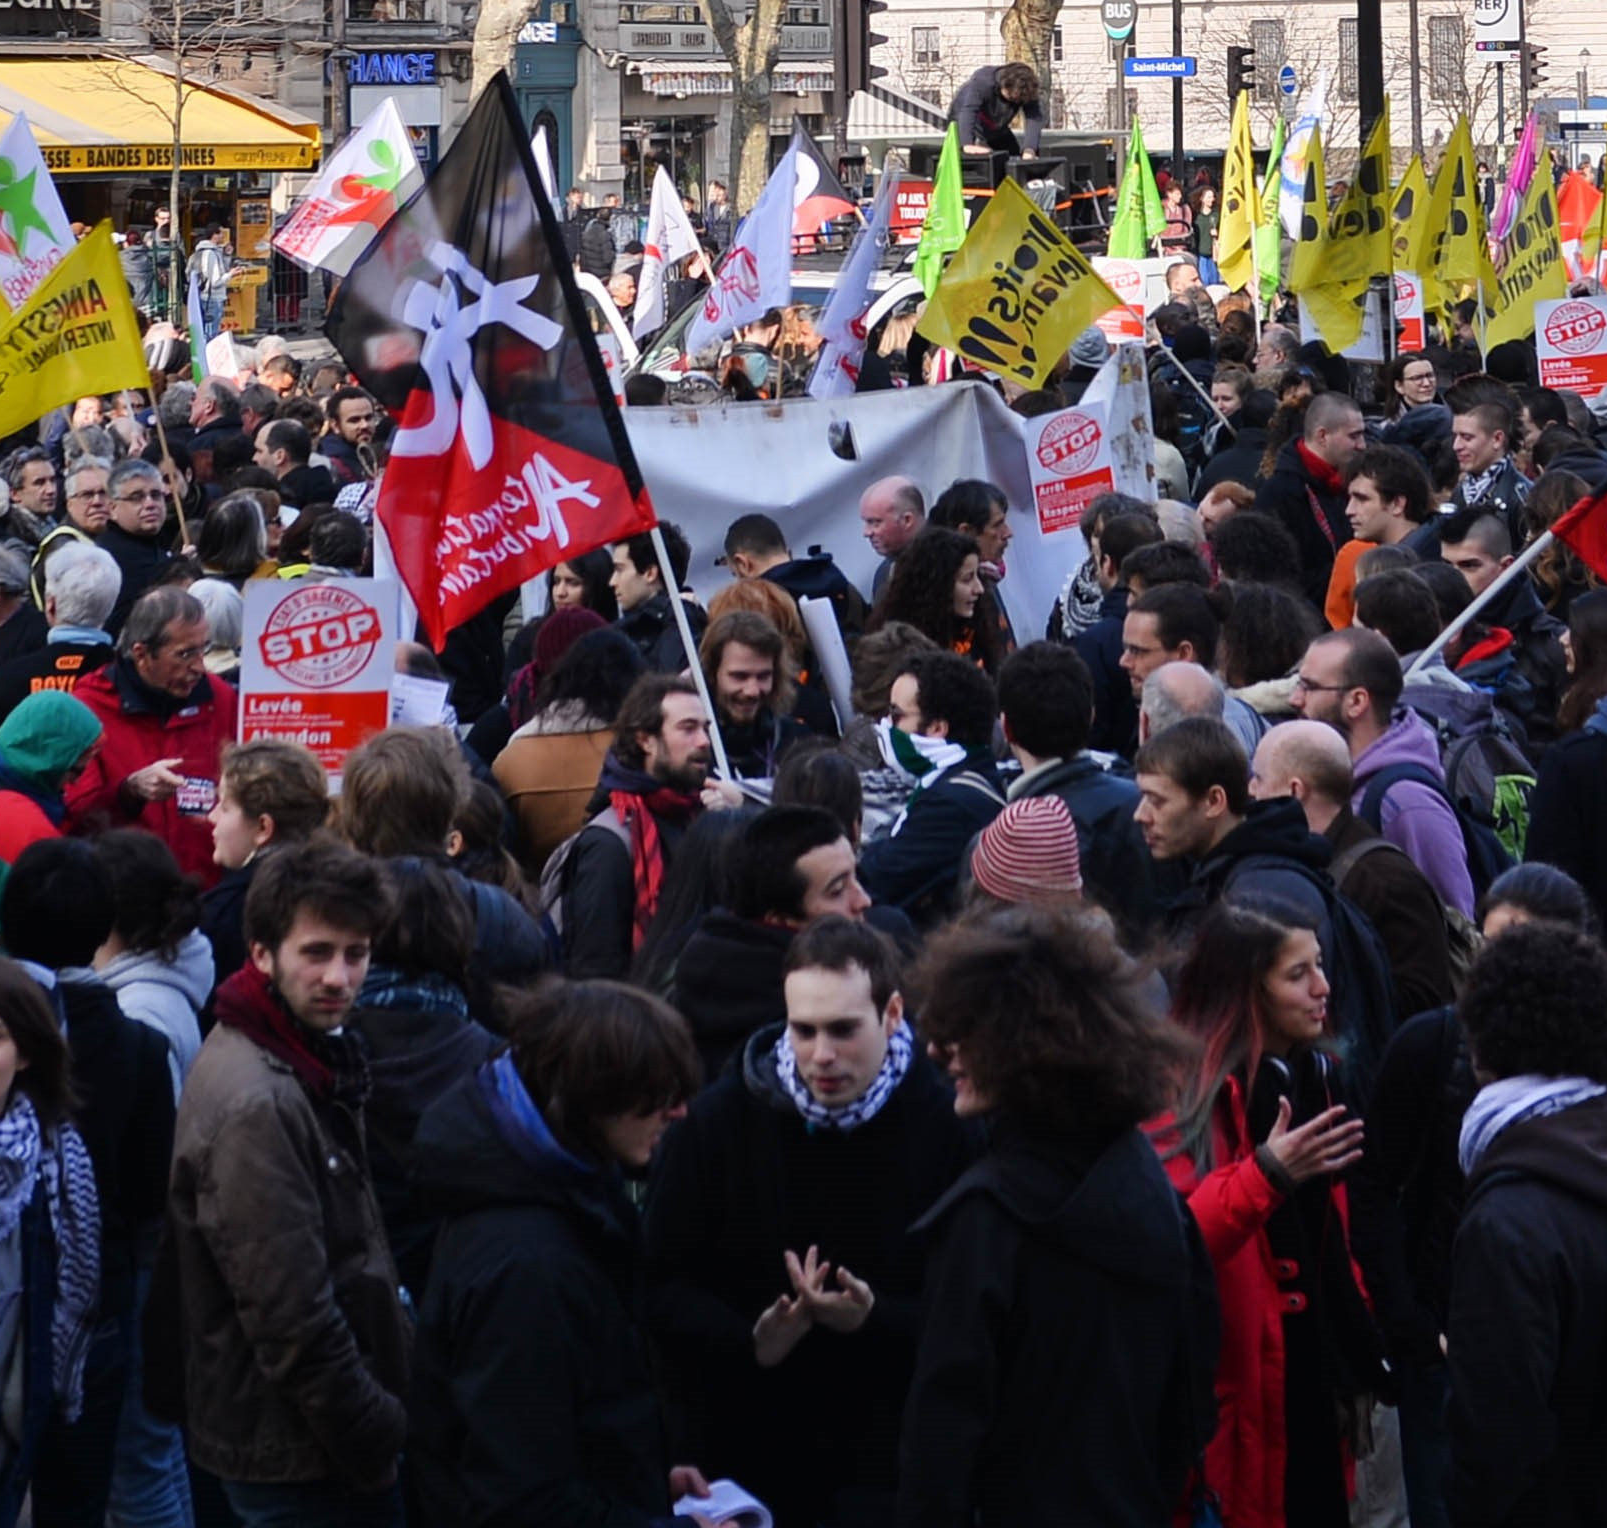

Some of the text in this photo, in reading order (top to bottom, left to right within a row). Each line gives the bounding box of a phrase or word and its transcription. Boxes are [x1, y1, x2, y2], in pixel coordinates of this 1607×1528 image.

[1105, 3, 1131, 18] BUS
[518, 23, 557, 43] NGE
[1132, 62, 1186, 72] Saint-Michel
[87, 148, 142, 167] BANDES
[1547, 314, 1603, 343] STOP
[1543, 359, 1572, 370] Levée
[1545, 375, 1588, 386] Abandon
[1040, 424, 1096, 466] STOP
[264, 613, 374, 663] STOP
[249, 697, 303, 714] Levée
